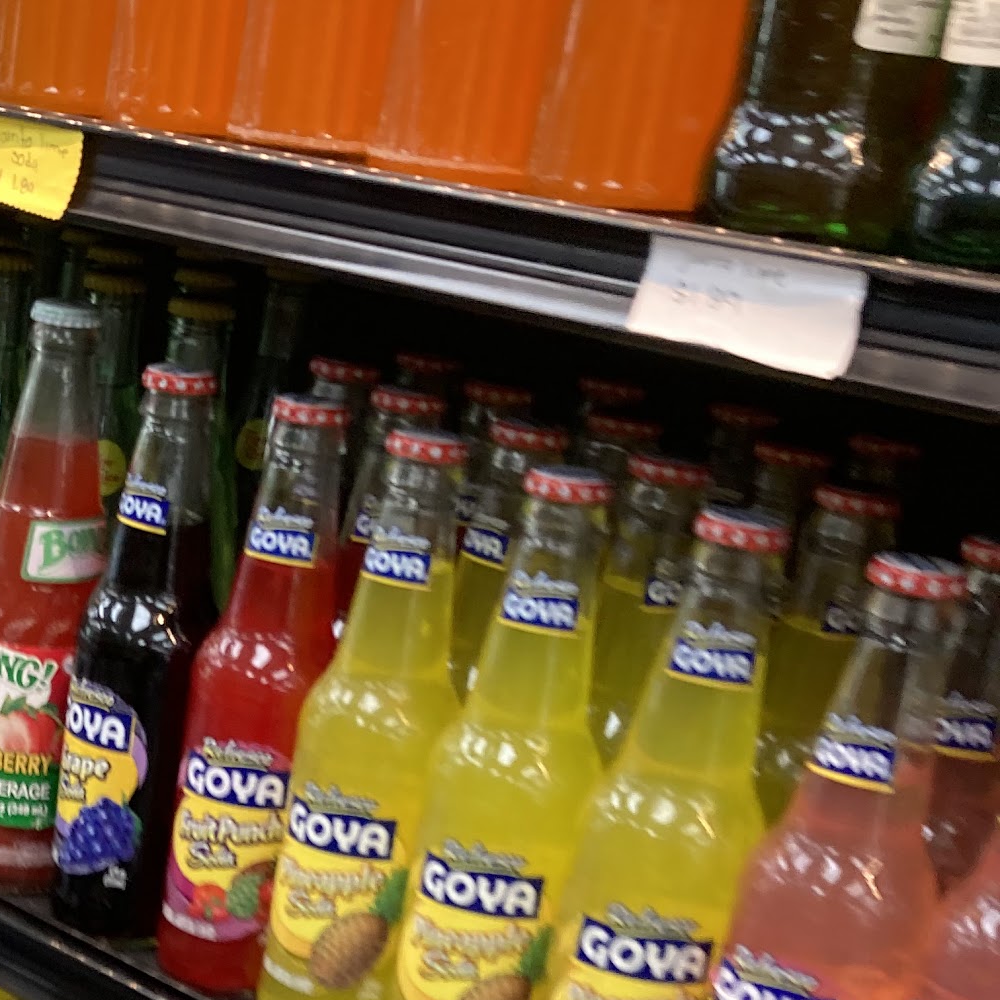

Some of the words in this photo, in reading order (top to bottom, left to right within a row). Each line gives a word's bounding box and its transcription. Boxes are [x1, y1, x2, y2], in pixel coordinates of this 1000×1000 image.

[249, 524, 313, 559] GOYA
[502, 591, 578, 630] GOYA
[187, 757, 286, 807] GOYA
[289, 801, 391, 858] GOYA
[422, 859, 539, 916] GOYA
[580, 924, 707, 982] GOYA
